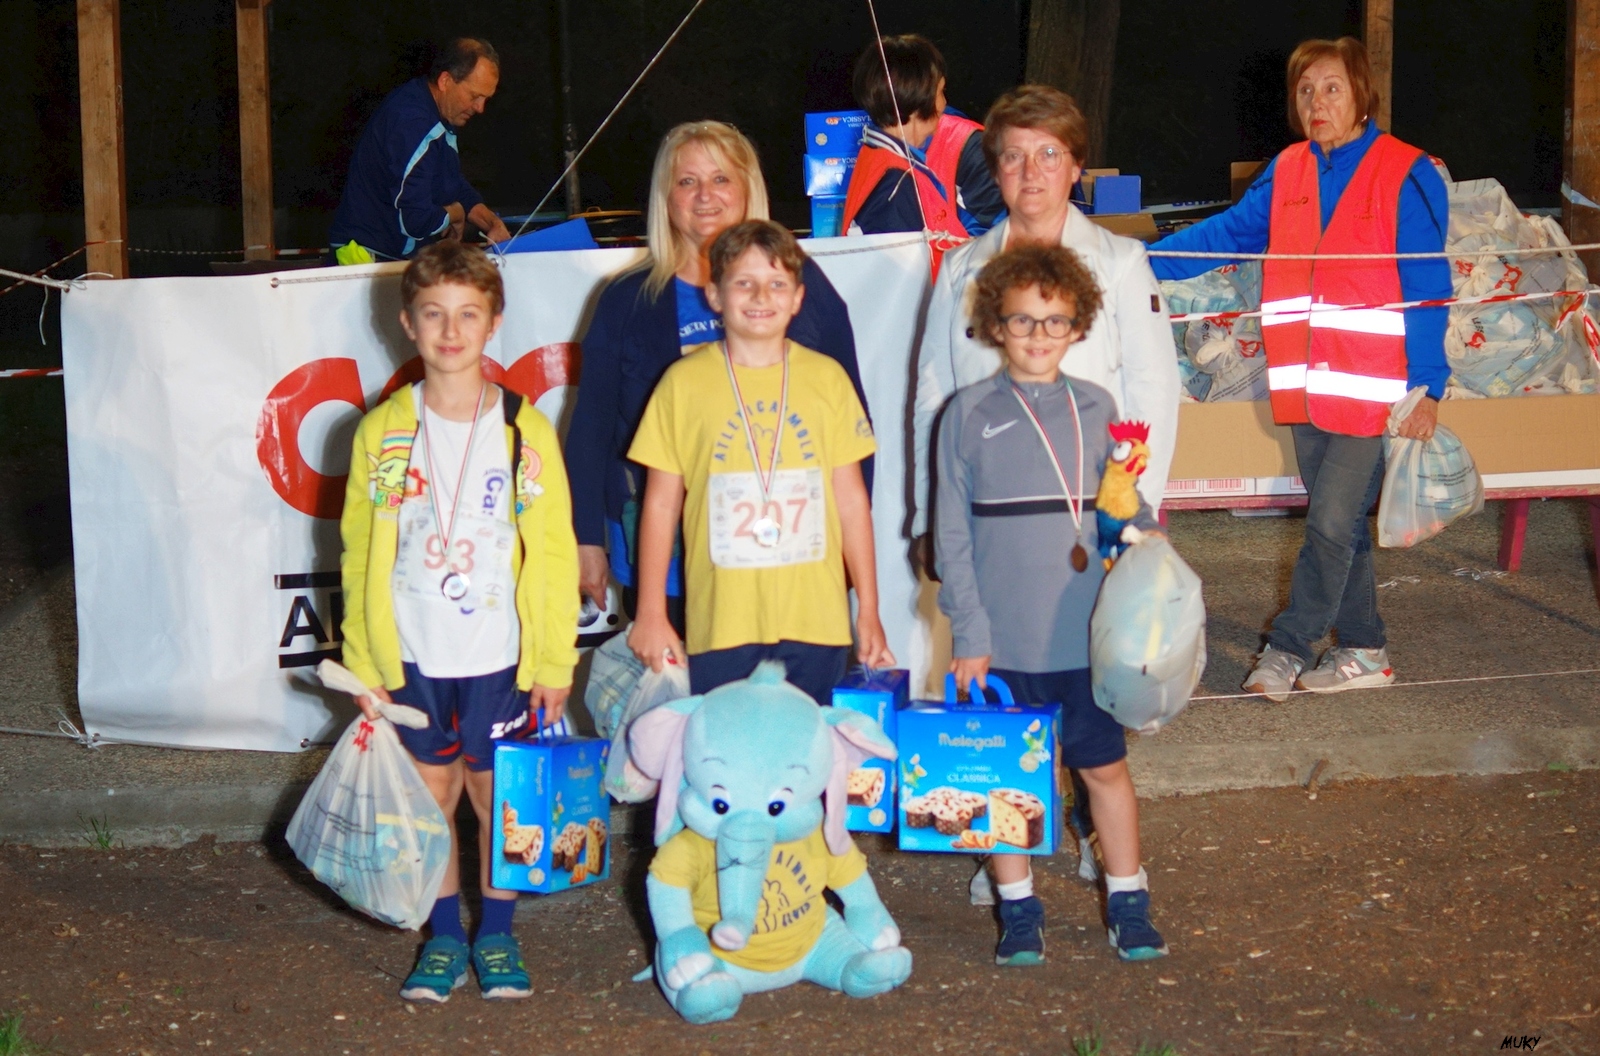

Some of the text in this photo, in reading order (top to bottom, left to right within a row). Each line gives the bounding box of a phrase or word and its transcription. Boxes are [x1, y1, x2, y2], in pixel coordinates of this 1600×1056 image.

[785, 404, 815, 460] MOLA
[732, 498, 807, 538] 207
[424, 533, 476, 575] 93
